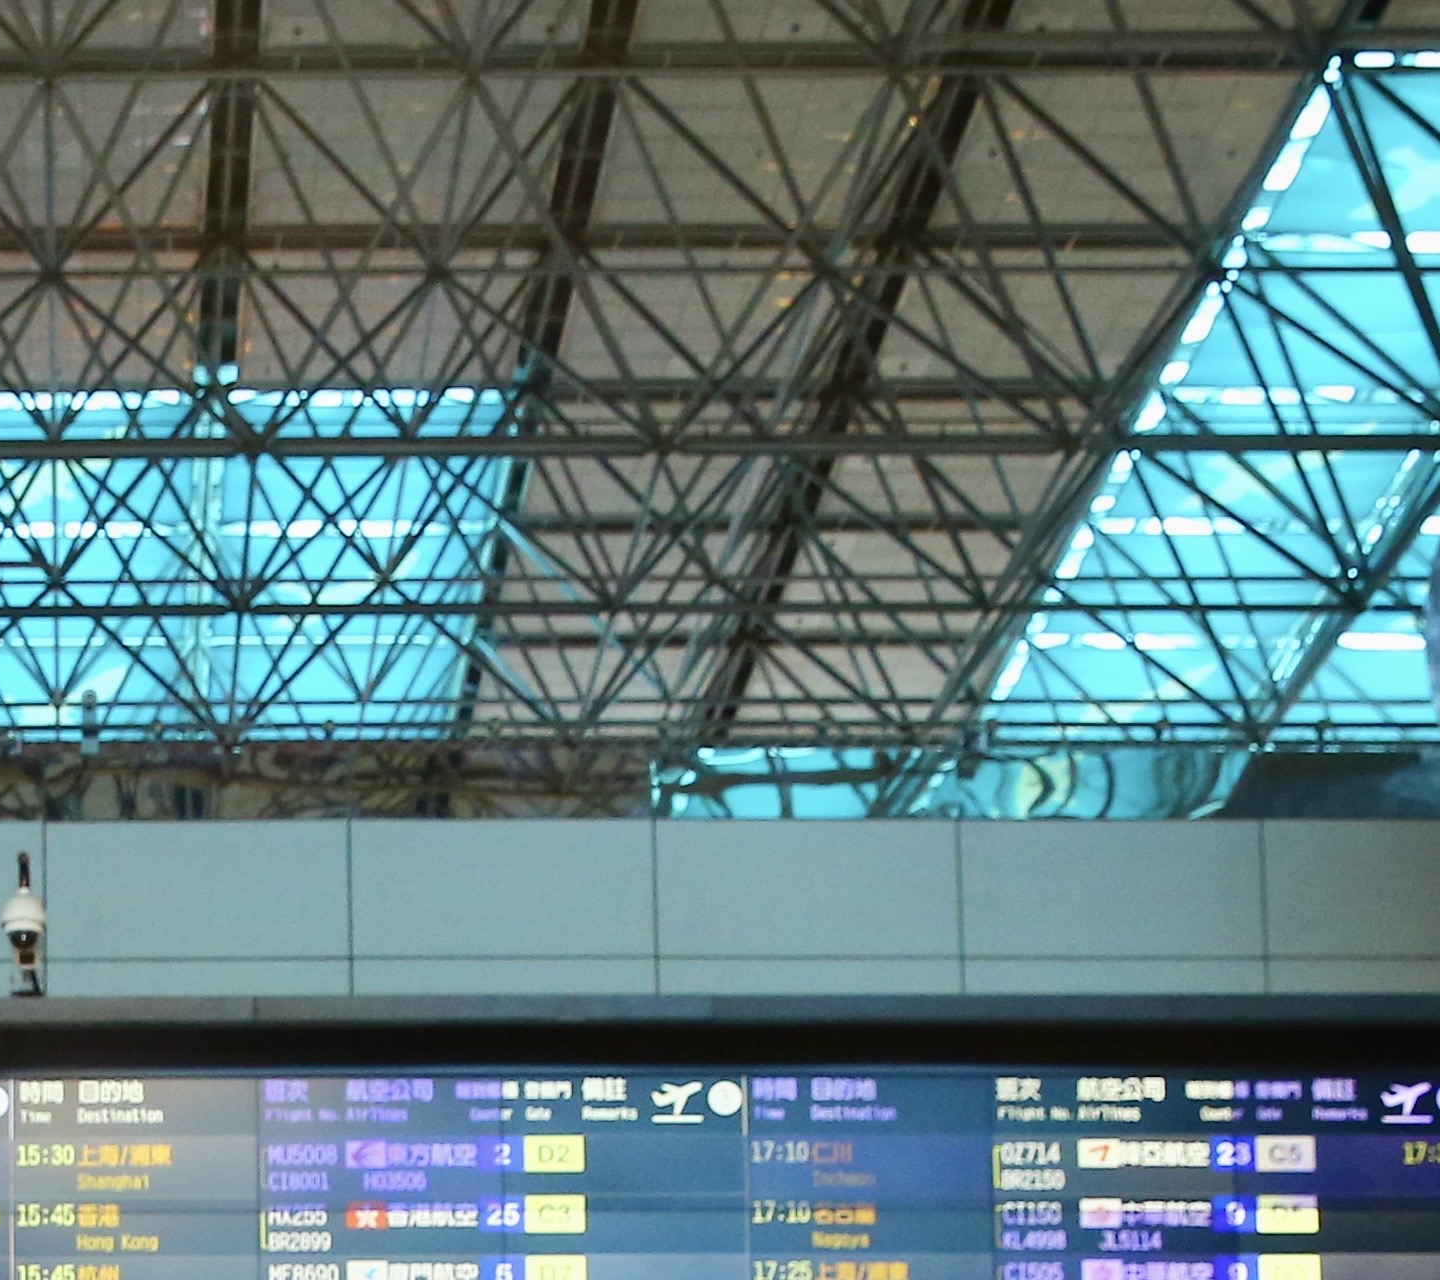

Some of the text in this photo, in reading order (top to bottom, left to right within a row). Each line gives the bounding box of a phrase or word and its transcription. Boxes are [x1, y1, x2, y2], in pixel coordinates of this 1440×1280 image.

[16, 1144, 75, 1167] 15:30
[493, 1144, 512, 1166] 2
[537, 1145, 570, 1164] D2
[751, 1141, 810, 1164] 17:10
[16, 1203, 76, 1227] 15:45
